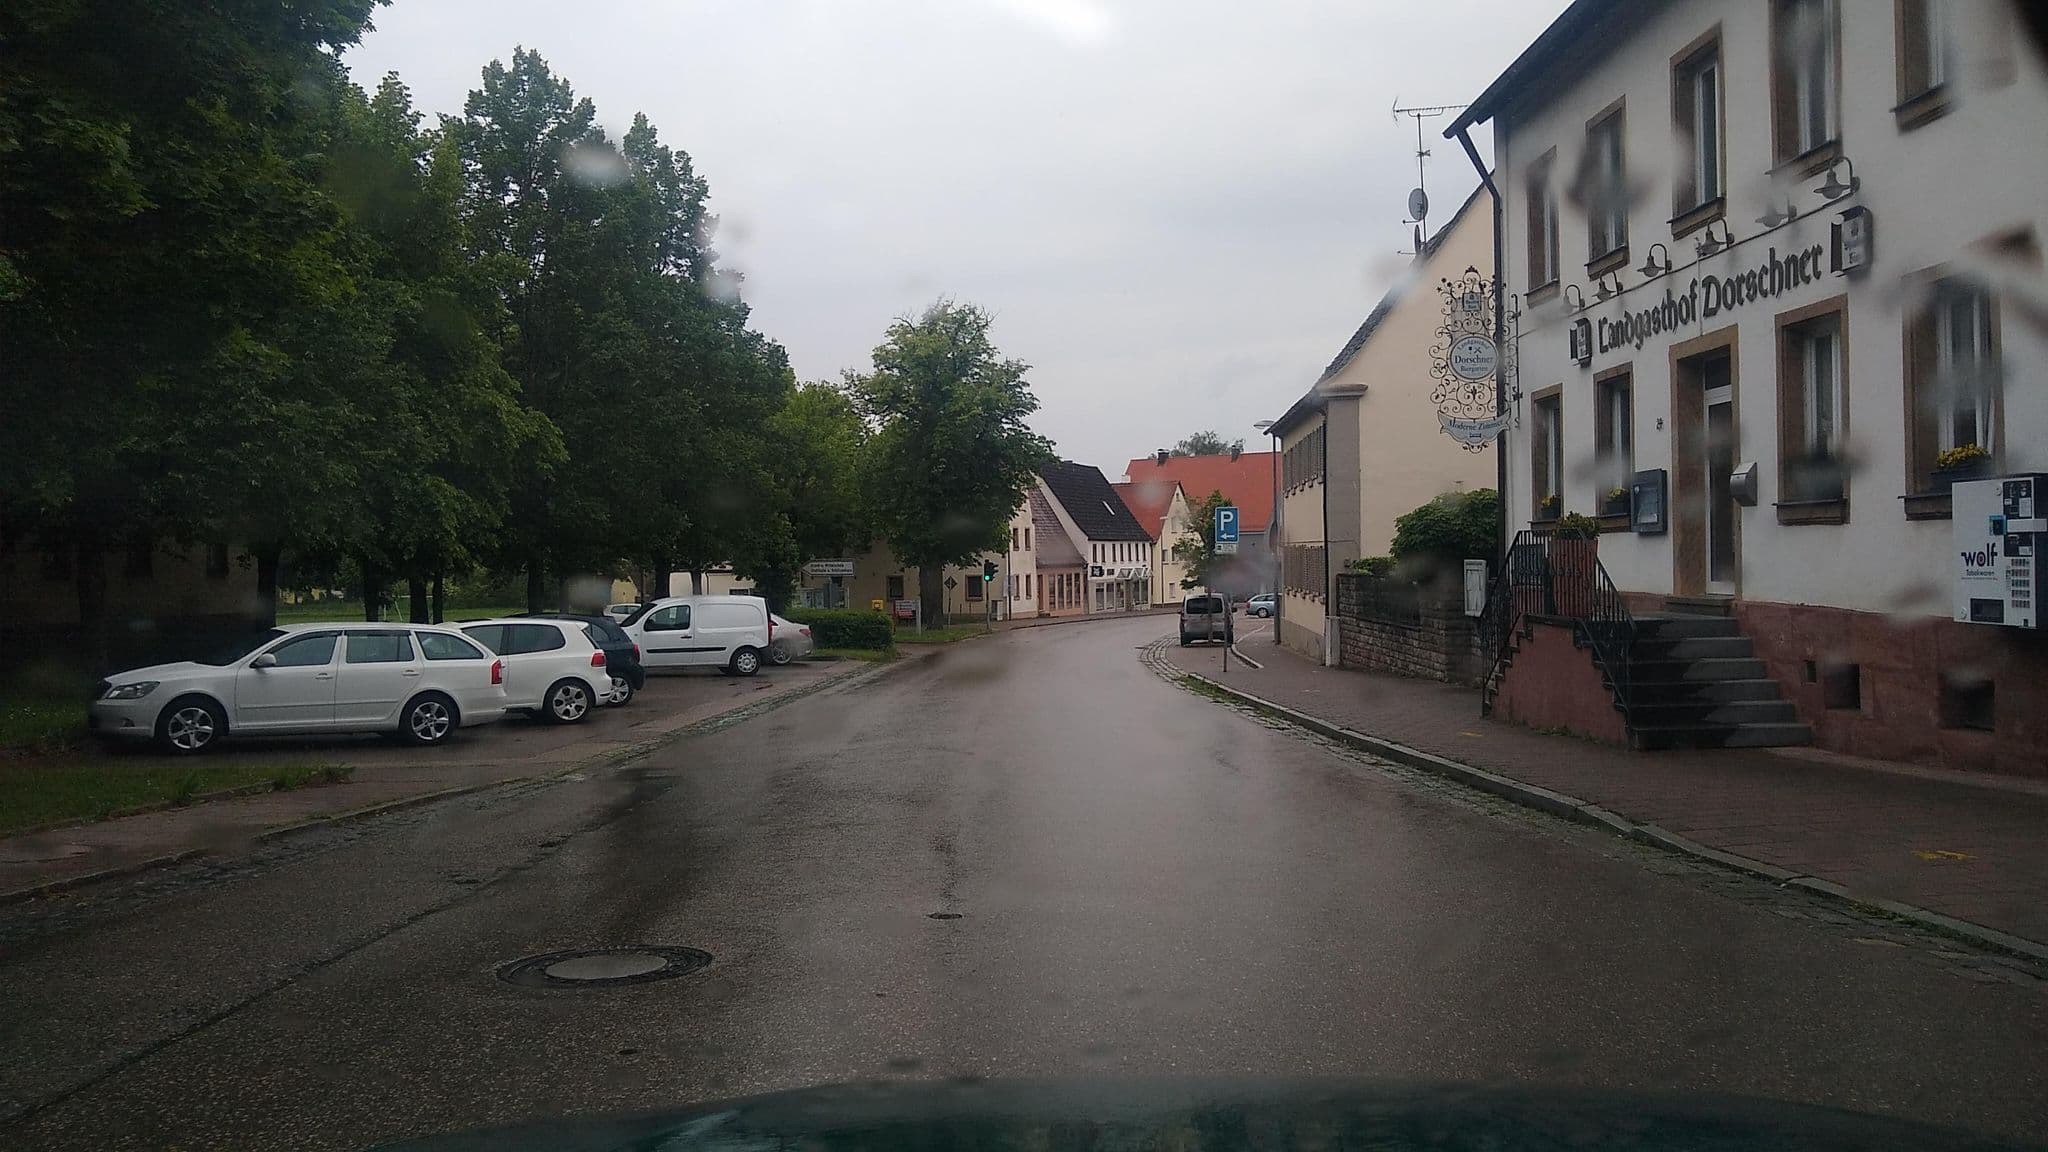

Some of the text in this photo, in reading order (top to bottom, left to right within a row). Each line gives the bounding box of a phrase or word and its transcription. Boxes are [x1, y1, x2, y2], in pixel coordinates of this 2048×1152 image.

[1598, 244, 1823, 354] Landgasthof Dorschner
[1455, 355, 1493, 364] Dorschner
[1220, 511, 1233, 531] P
[1961, 543, 1998, 567] wolf
